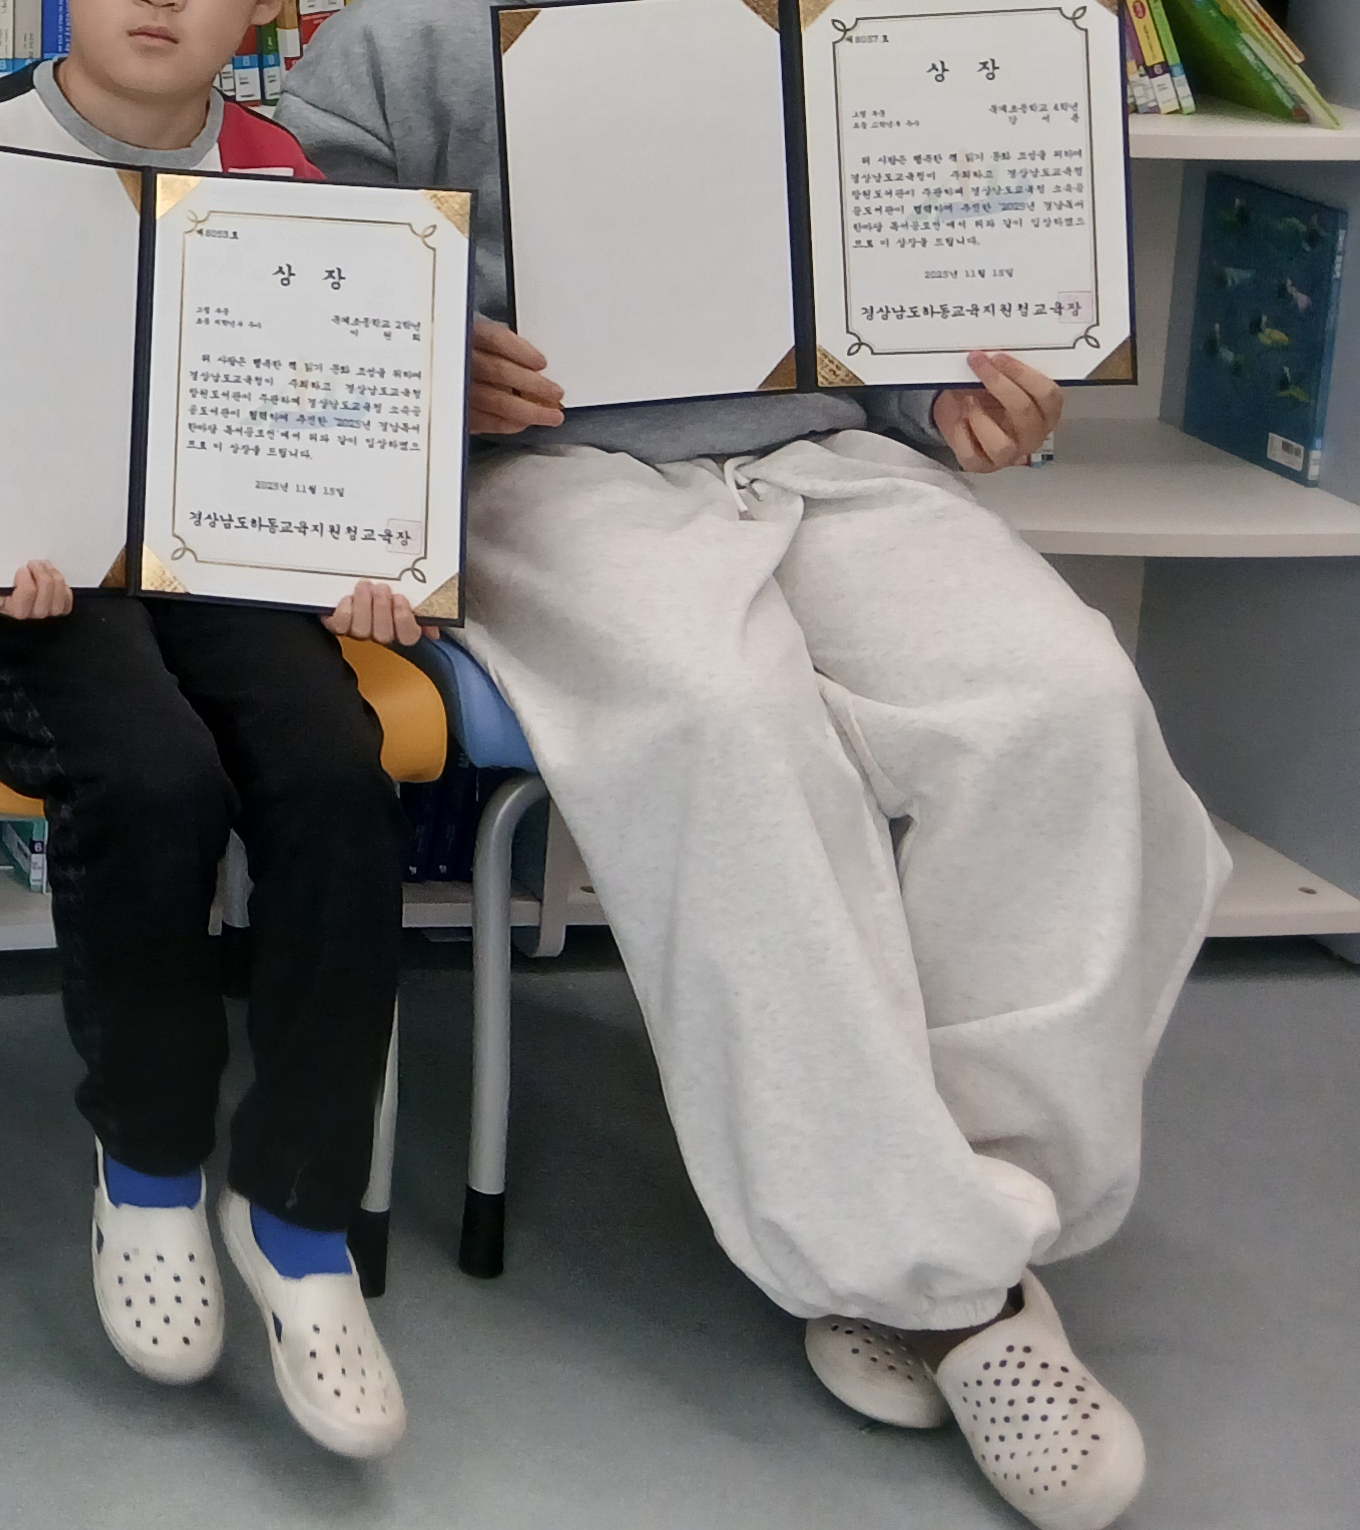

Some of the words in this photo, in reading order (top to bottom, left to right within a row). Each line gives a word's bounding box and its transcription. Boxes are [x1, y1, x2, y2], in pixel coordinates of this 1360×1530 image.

[927, 60, 950, 83] 상
[976, 58, 1000, 81] 장
[272, 264, 296, 286] 상
[322, 267, 346, 290] 장
[861, 302, 1082, 321] 경상남도하동교육지원청교육장
[190, 510, 412, 546] 경상남도하동교육지원청교육장
